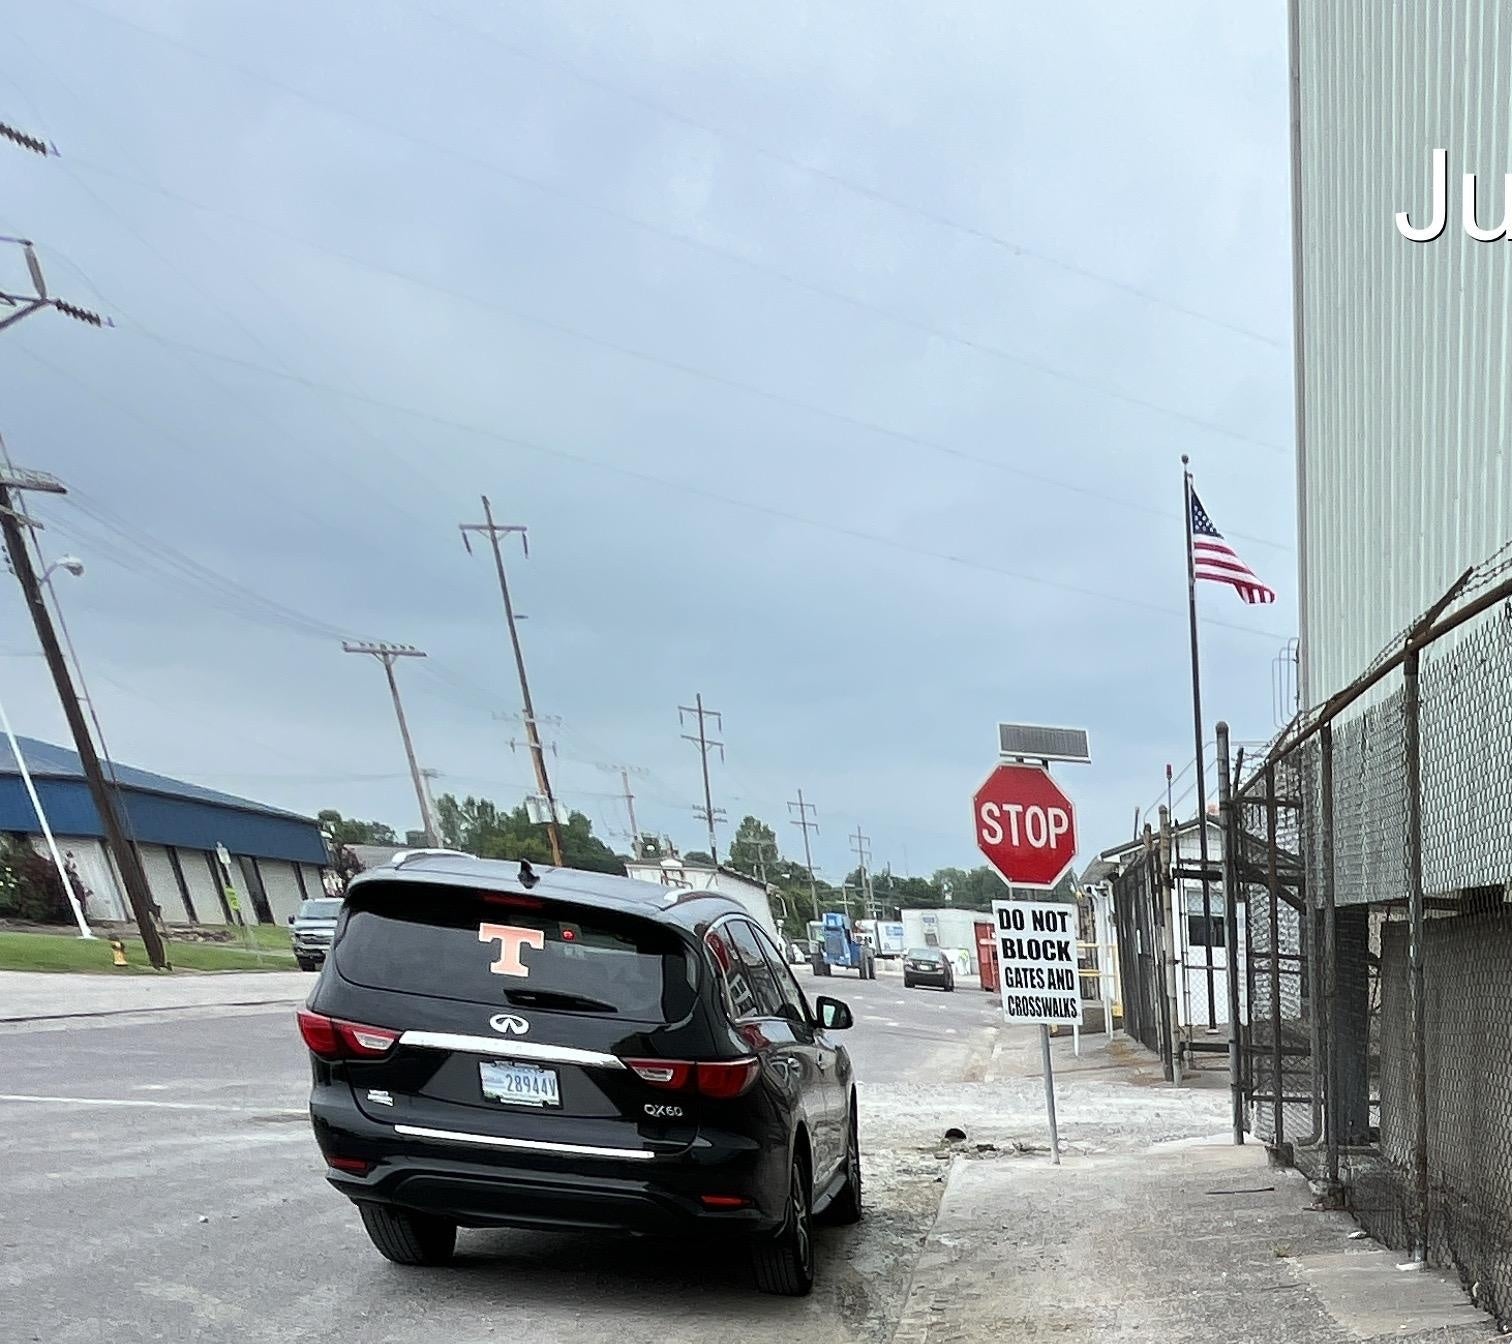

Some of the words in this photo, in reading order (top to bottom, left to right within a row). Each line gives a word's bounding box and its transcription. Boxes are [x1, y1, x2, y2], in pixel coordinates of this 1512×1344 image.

[980, 803, 1070, 849] STOP
[998, 908, 1025, 931] DO
[1031, 910, 1068, 932] NOT
[479, 922, 544, 977] T
[1001, 937, 1072, 961] BLOCK
[1005, 966, 1045, 989] GATES
[1047, 967, 1075, 990] AND
[1007, 995, 1078, 1018] CROSSWALKS
[644, 1103, 684, 1117] QX60
